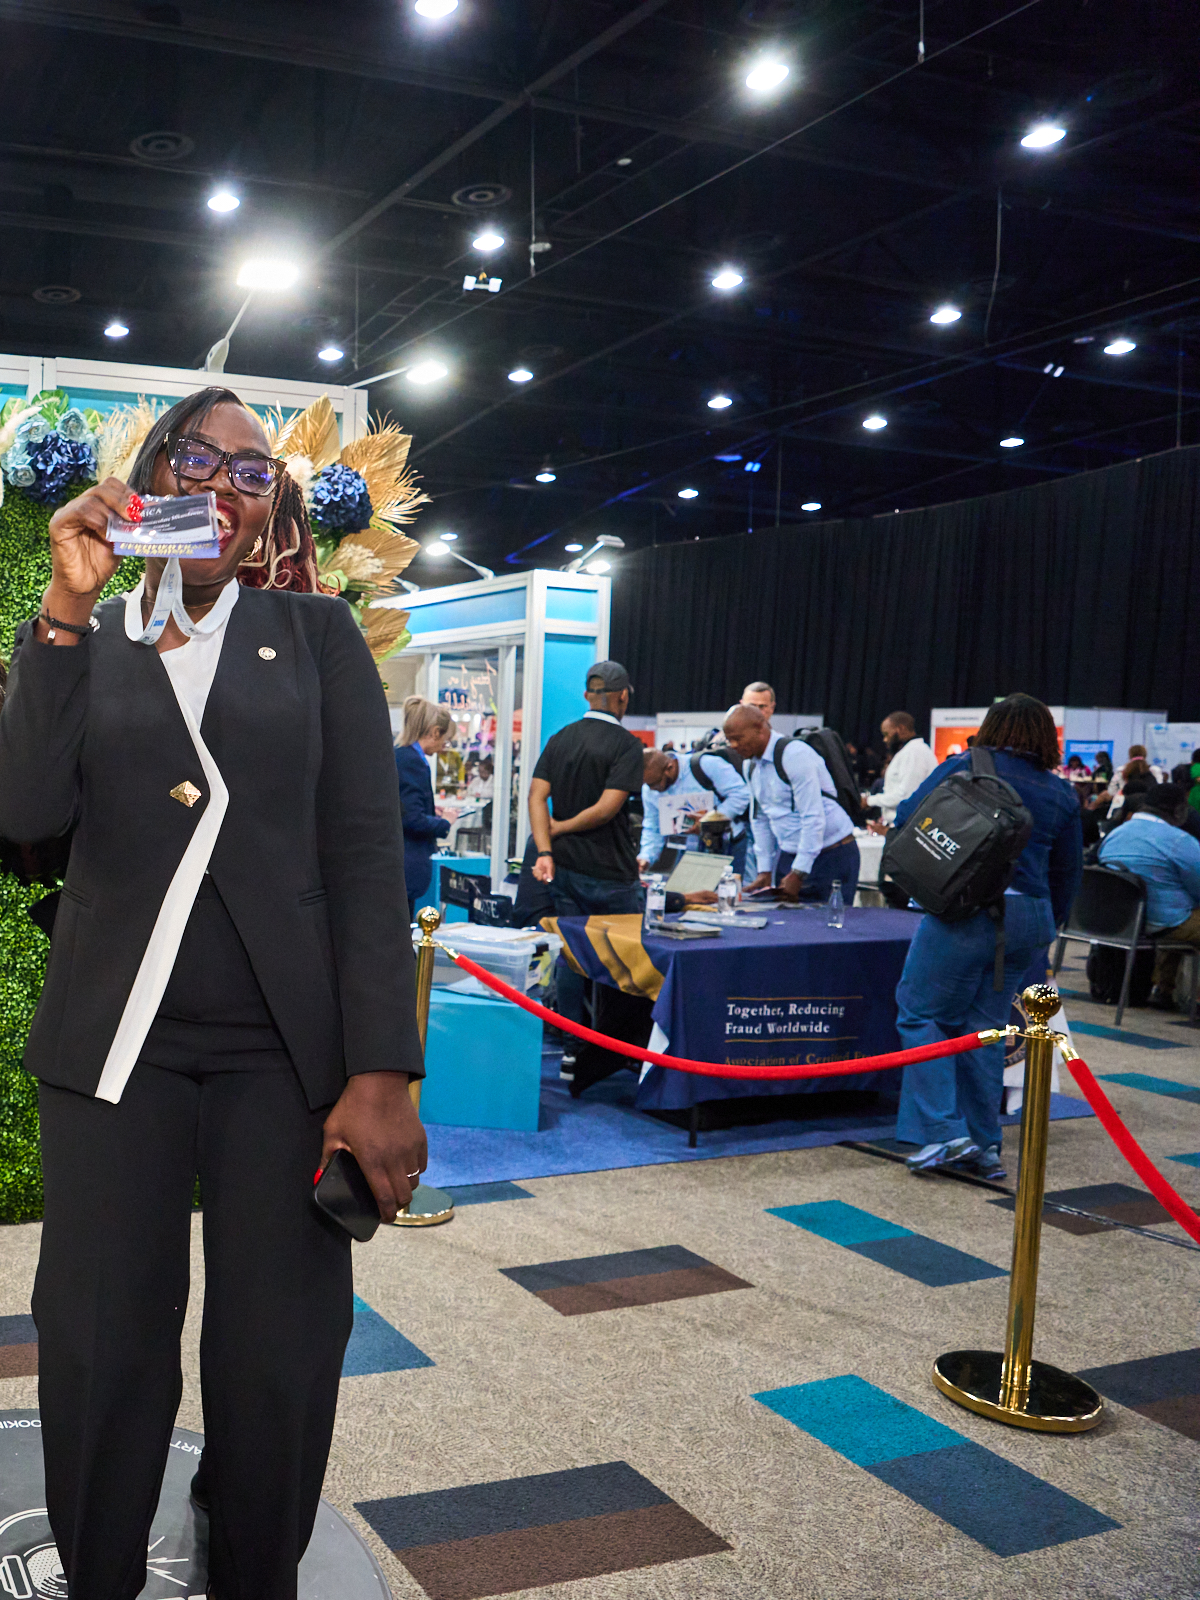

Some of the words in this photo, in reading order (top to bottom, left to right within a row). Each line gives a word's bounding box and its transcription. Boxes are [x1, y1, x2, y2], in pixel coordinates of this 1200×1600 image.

[927, 827, 961, 855] ACFE
[727, 1003, 784, 1018] Together,
[788, 1003, 845, 1018] Reducing
[725, 1022, 762, 1034] Fraud
[767, 1021, 830, 1033] Worldwide
[789, 1053, 801, 1065] of
